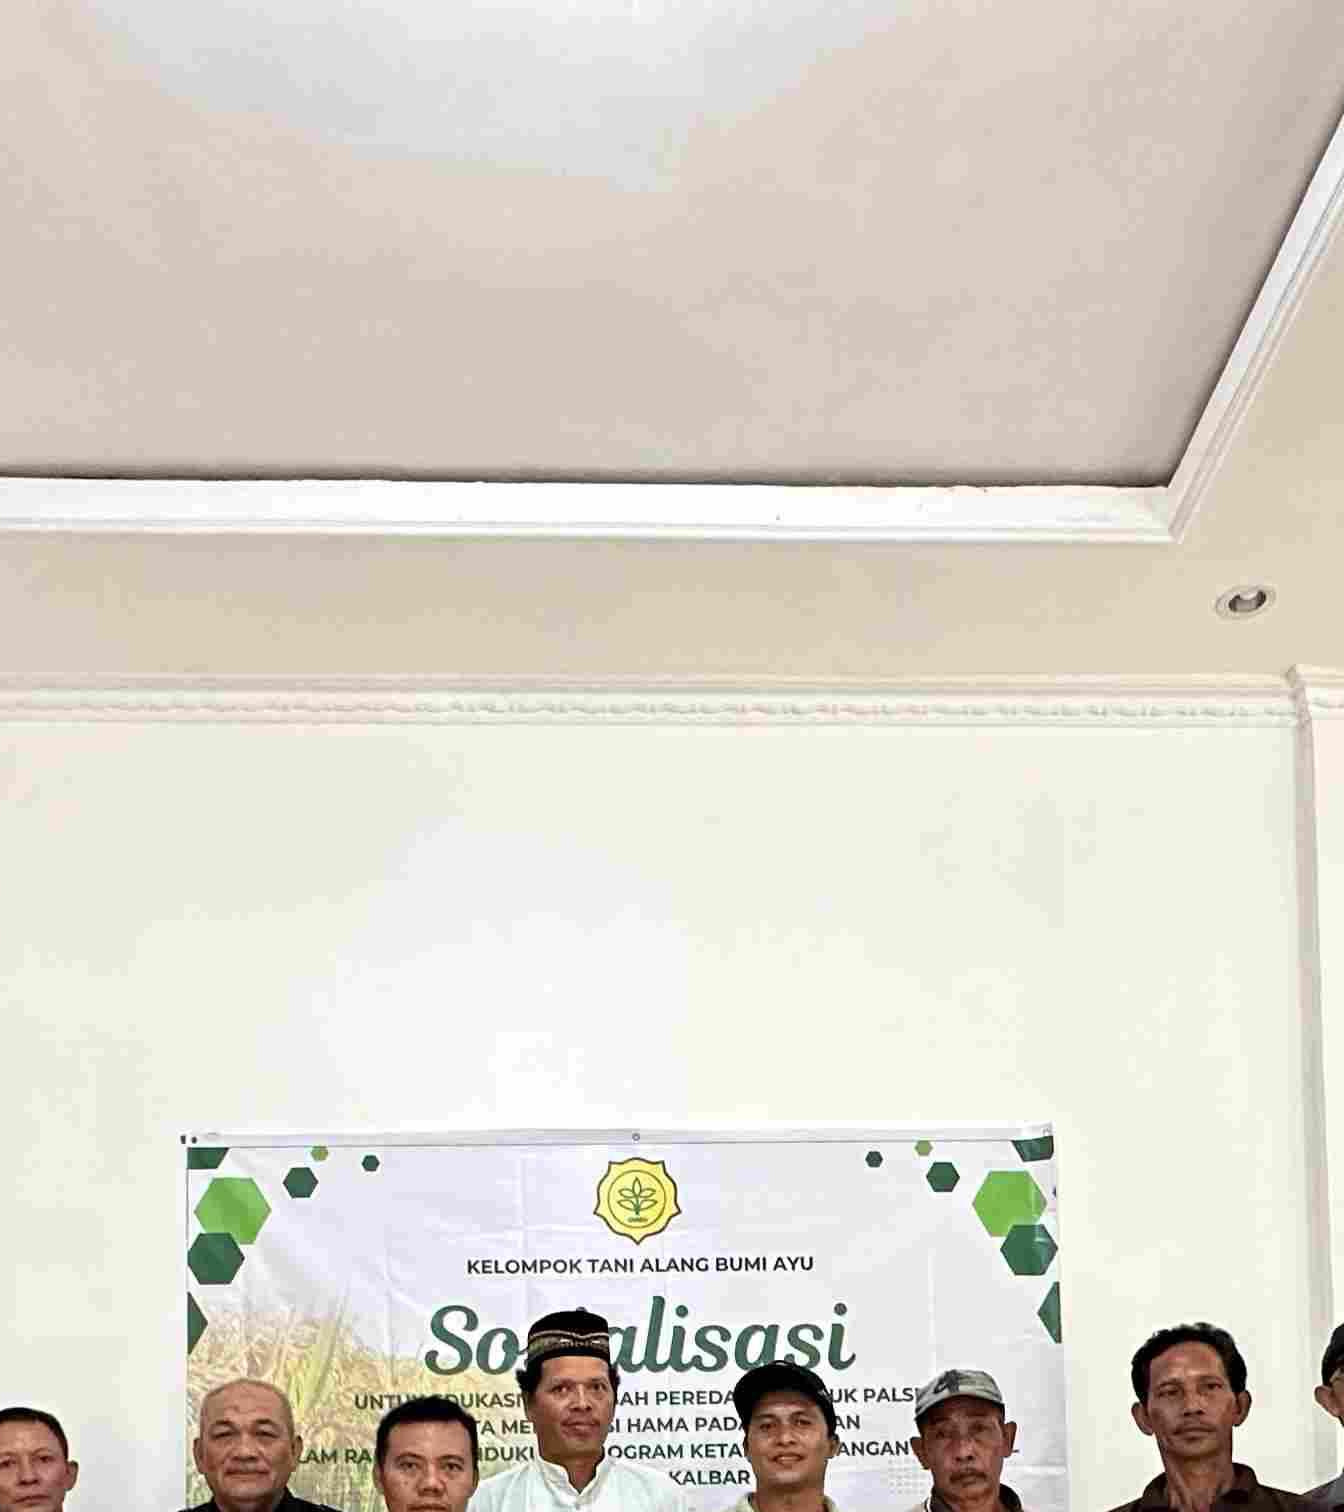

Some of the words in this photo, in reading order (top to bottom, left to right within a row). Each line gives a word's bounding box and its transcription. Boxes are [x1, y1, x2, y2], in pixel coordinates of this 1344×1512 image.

[466, 1259, 583, 1275] KELOMPOK
[587, 1258, 635, 1274] TANI
[639, 1257, 710, 1273] ALANG
[715, 1257, 768, 1272] BUMI
[772, 1256, 815, 1272] AYU
[424, 1295, 856, 1376] Soalisasi
[863, 1387, 918, 1402] PALS
[627, 1417, 689, 1433] HAMA
[607, 1444, 684, 1460] OGRAM
[839, 1441, 909, 1457] ANGAN
[669, 1470, 751, 1486] KALBAR
